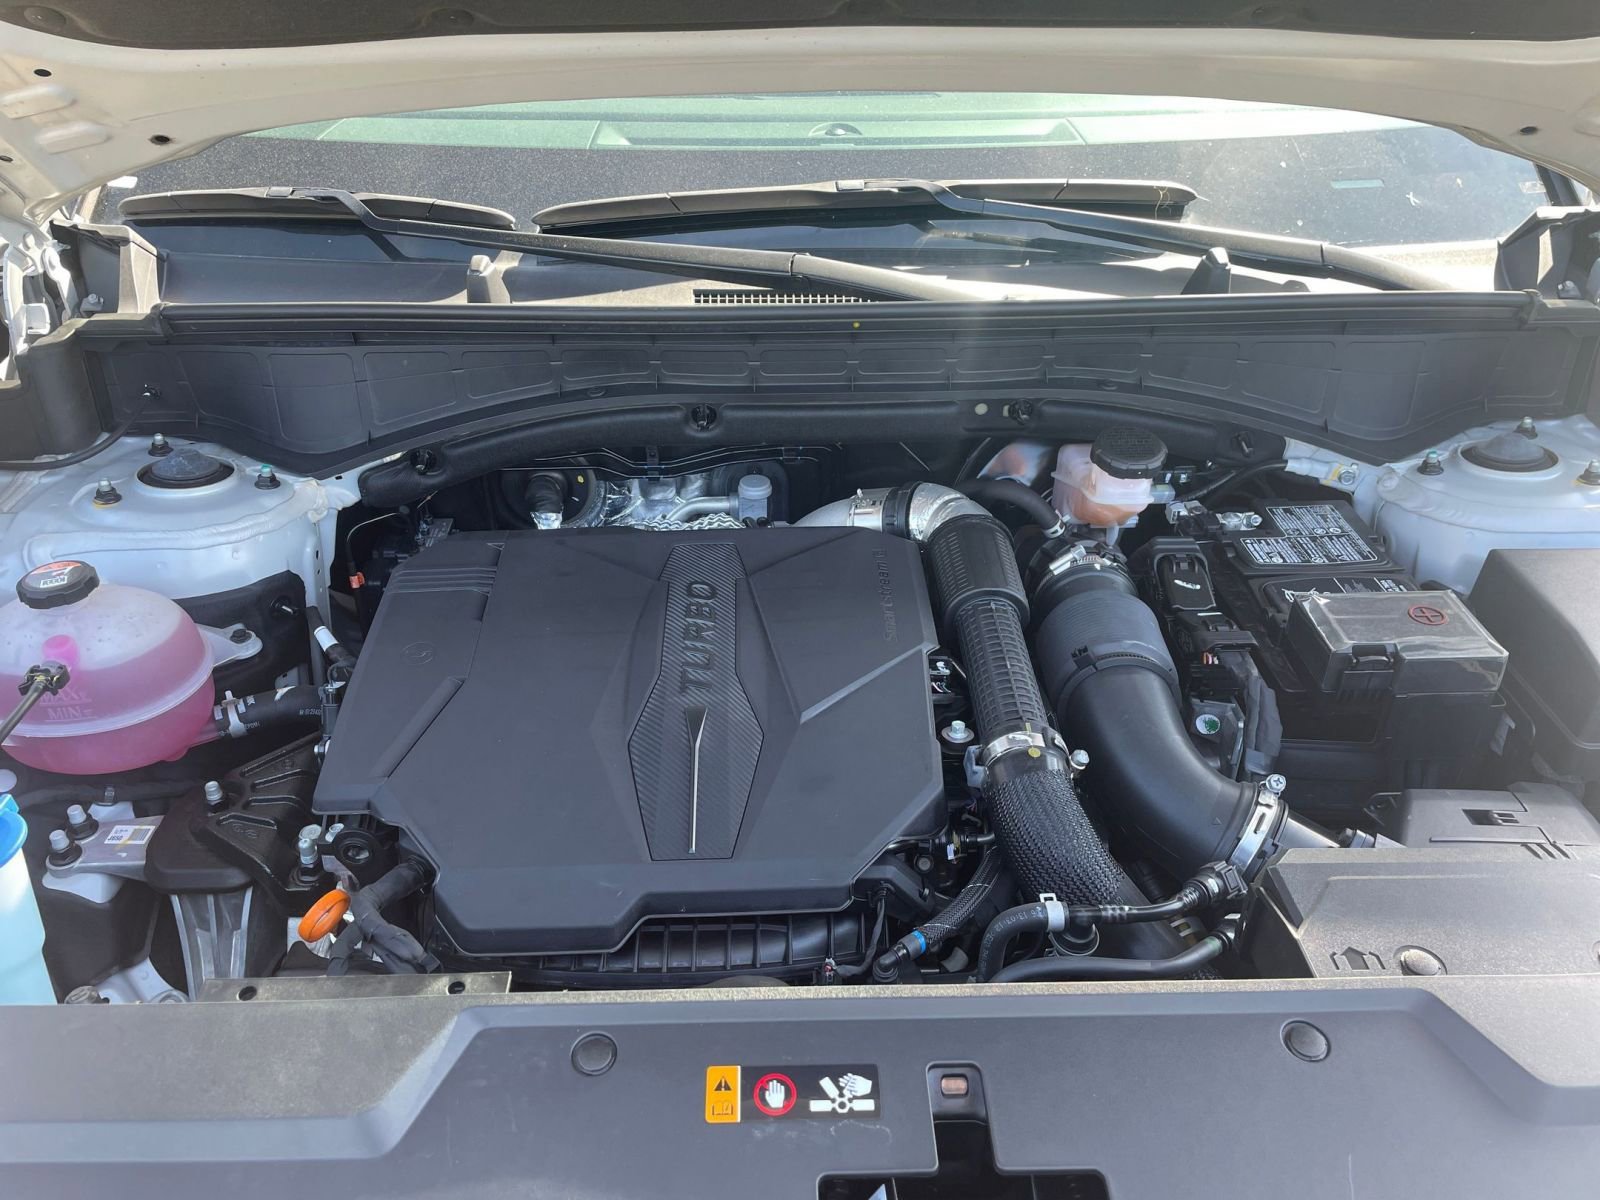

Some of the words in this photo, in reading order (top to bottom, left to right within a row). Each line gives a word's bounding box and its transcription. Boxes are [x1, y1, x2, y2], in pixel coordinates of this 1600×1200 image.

[680, 581, 717, 696] TURBO
[877, 560, 897, 641] Smartstream
[47, 706, 81, 721] MIN
